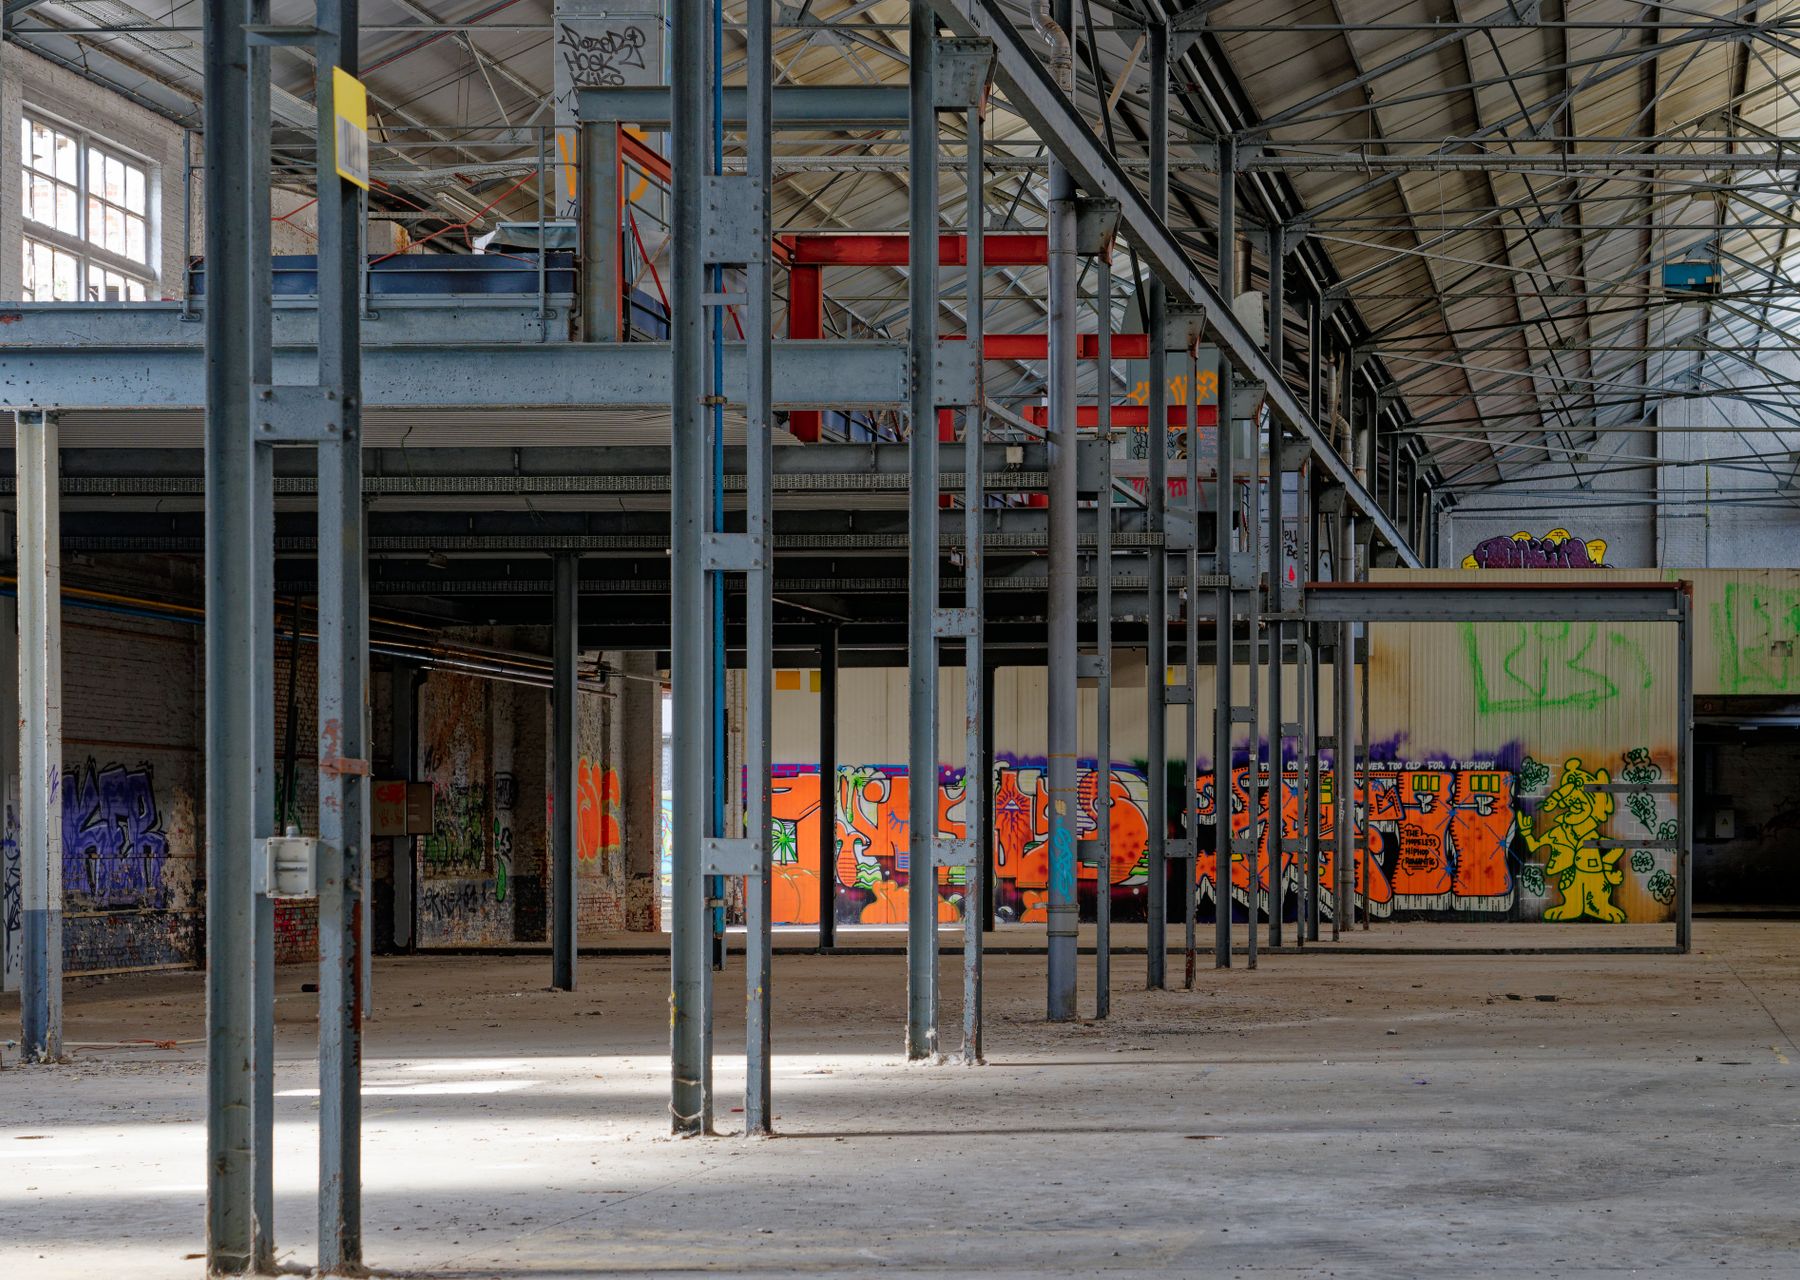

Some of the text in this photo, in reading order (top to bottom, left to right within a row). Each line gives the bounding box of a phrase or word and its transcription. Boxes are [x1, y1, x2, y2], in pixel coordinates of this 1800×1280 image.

[1356, 762, 1384, 771] NVER
[1387, 762, 1402, 770] TOO
[1405, 762, 1421, 770] OLD
[1428, 761, 1445, 770] FOR
[1450, 761, 1457, 770] A
[1404, 829, 1420, 837] THE
